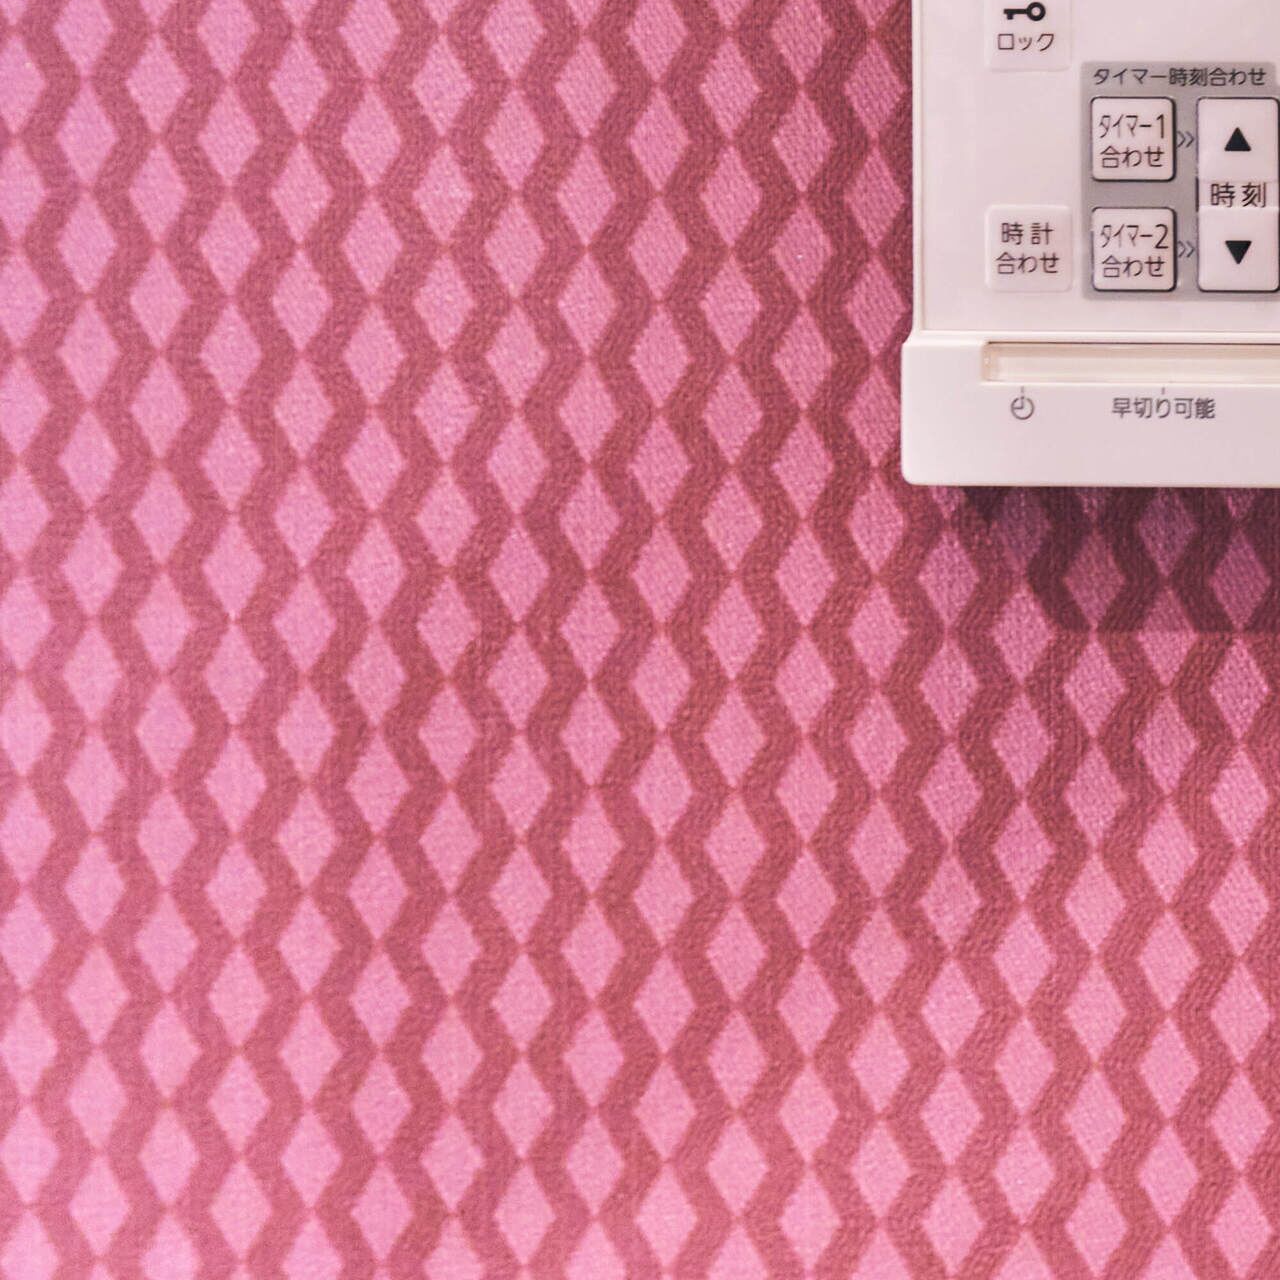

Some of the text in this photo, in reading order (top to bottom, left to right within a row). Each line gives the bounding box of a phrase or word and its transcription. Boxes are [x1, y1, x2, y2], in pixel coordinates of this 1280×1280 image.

[996, 32, 1056, 52] ロック
[1092, 66, 1267, 88] タイマー時刻合わせ
[1099, 113, 1166, 140] タイマー1
[1100, 145, 1166, 169] 合わせ
[1210, 181, 1268, 209] 時刻
[1001, 221, 1054, 246] 時計
[1100, 222, 1170, 250] タイマー2
[995, 252, 1060, 275] 合わせ
[1101, 255, 1166, 279] 合わせ
[1111, 397, 1216, 420] 早切り可能
